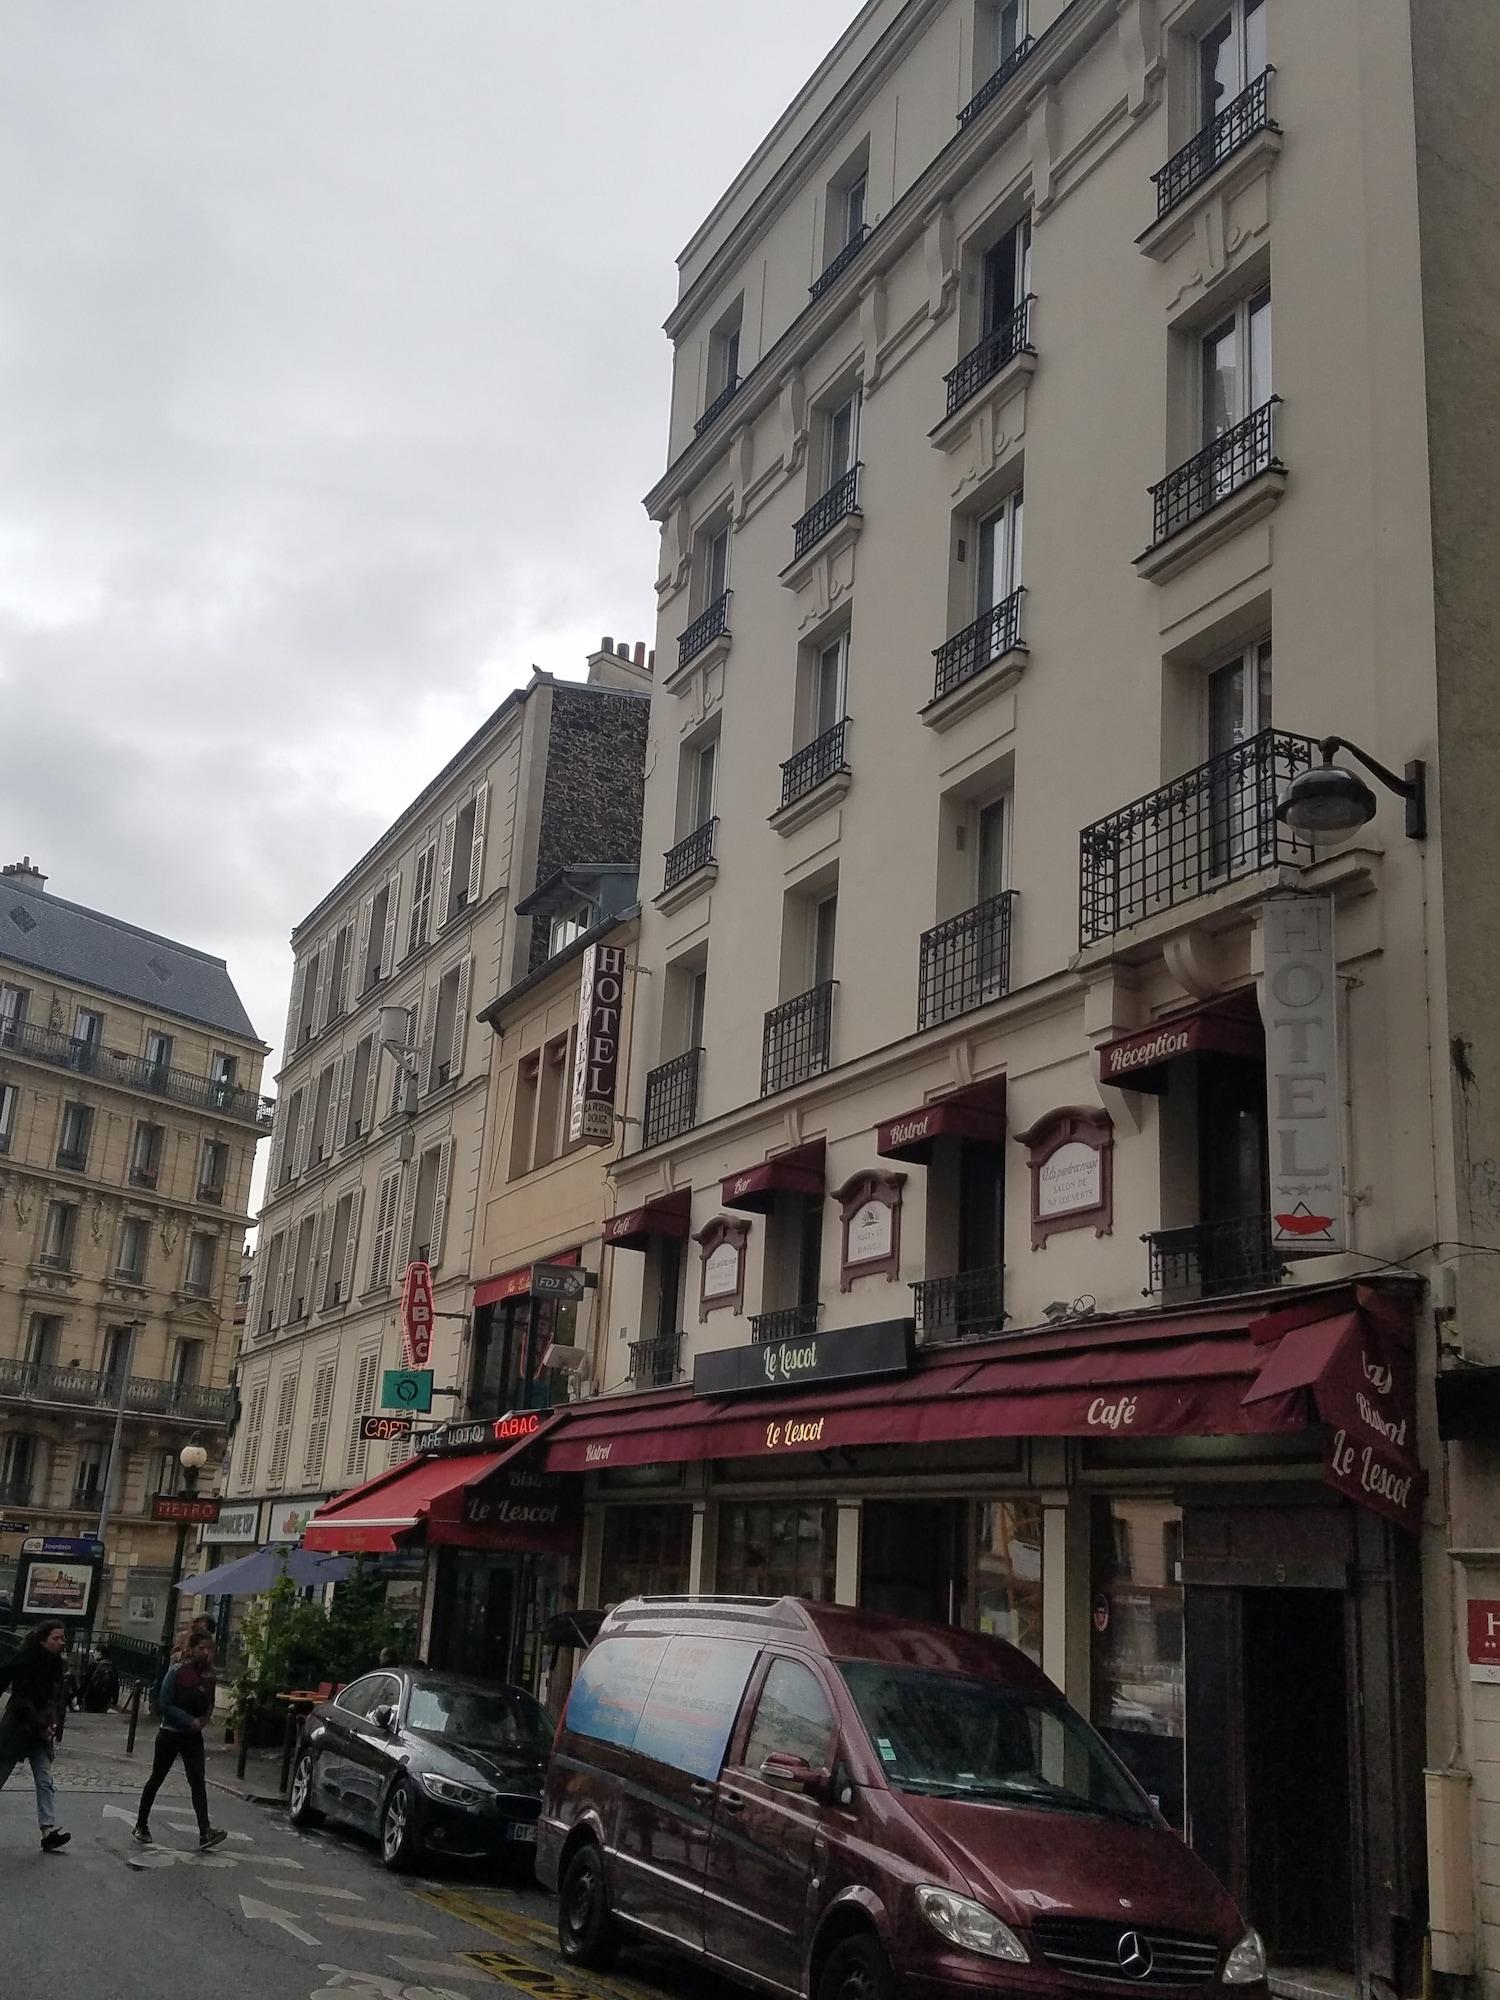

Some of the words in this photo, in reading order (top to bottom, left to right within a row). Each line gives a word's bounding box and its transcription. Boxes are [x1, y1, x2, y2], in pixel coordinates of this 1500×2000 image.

[588, 946, 622, 1096] HOTEL
[1110, 1030, 1188, 1071] Réception
[1270, 906, 1329, 1176] HOTEL
[890, 1116, 928, 1145] Bistrot
[733, 1178, 751, 1195] Bar
[539, 1277, 560, 1289] FDJ
[412, 1269, 430, 1358] TABAC
[764, 1346, 777, 1381] Le
[779, 1342, 817, 1379] Lescot
[492, 1415, 540, 1439] TABAC
[1087, 1396, 1138, 1430] Café
[766, 1422, 781, 1449] Le
[785, 1417, 824, 1446] Lescot
[1332, 1429, 1355, 1476] Le
[1361, 1446, 1412, 1509] Lescot
[468, 1498, 490, 1522] Le
[499, 1500, 559, 1523] Lescot
